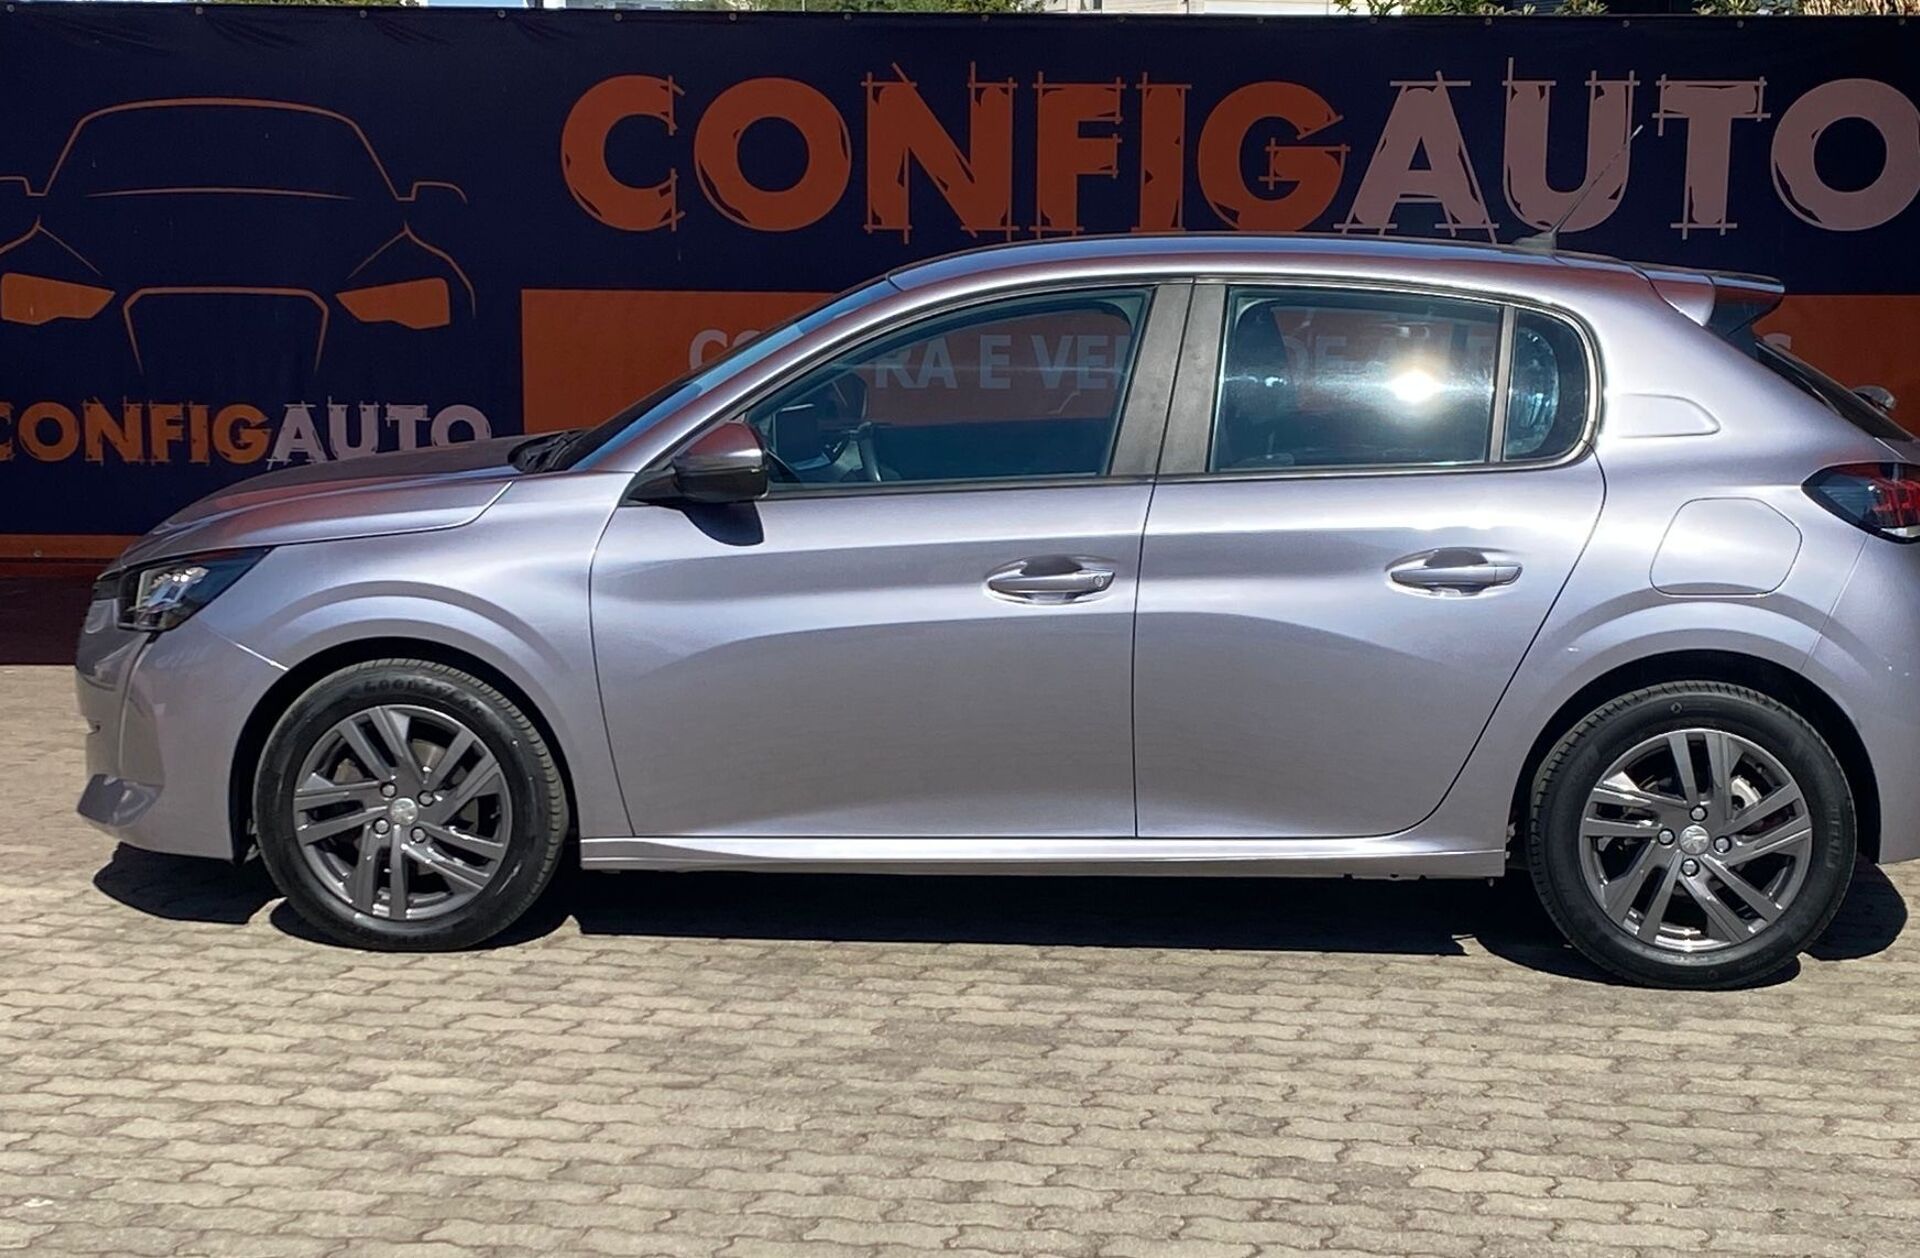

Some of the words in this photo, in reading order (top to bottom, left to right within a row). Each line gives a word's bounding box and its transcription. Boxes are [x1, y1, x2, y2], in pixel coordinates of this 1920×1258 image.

[561, 58, 1920, 243] CONFIGAUTO
[979, 335, 1011, 388] E
[0, 396, 492, 470] ONFIGAUTO
